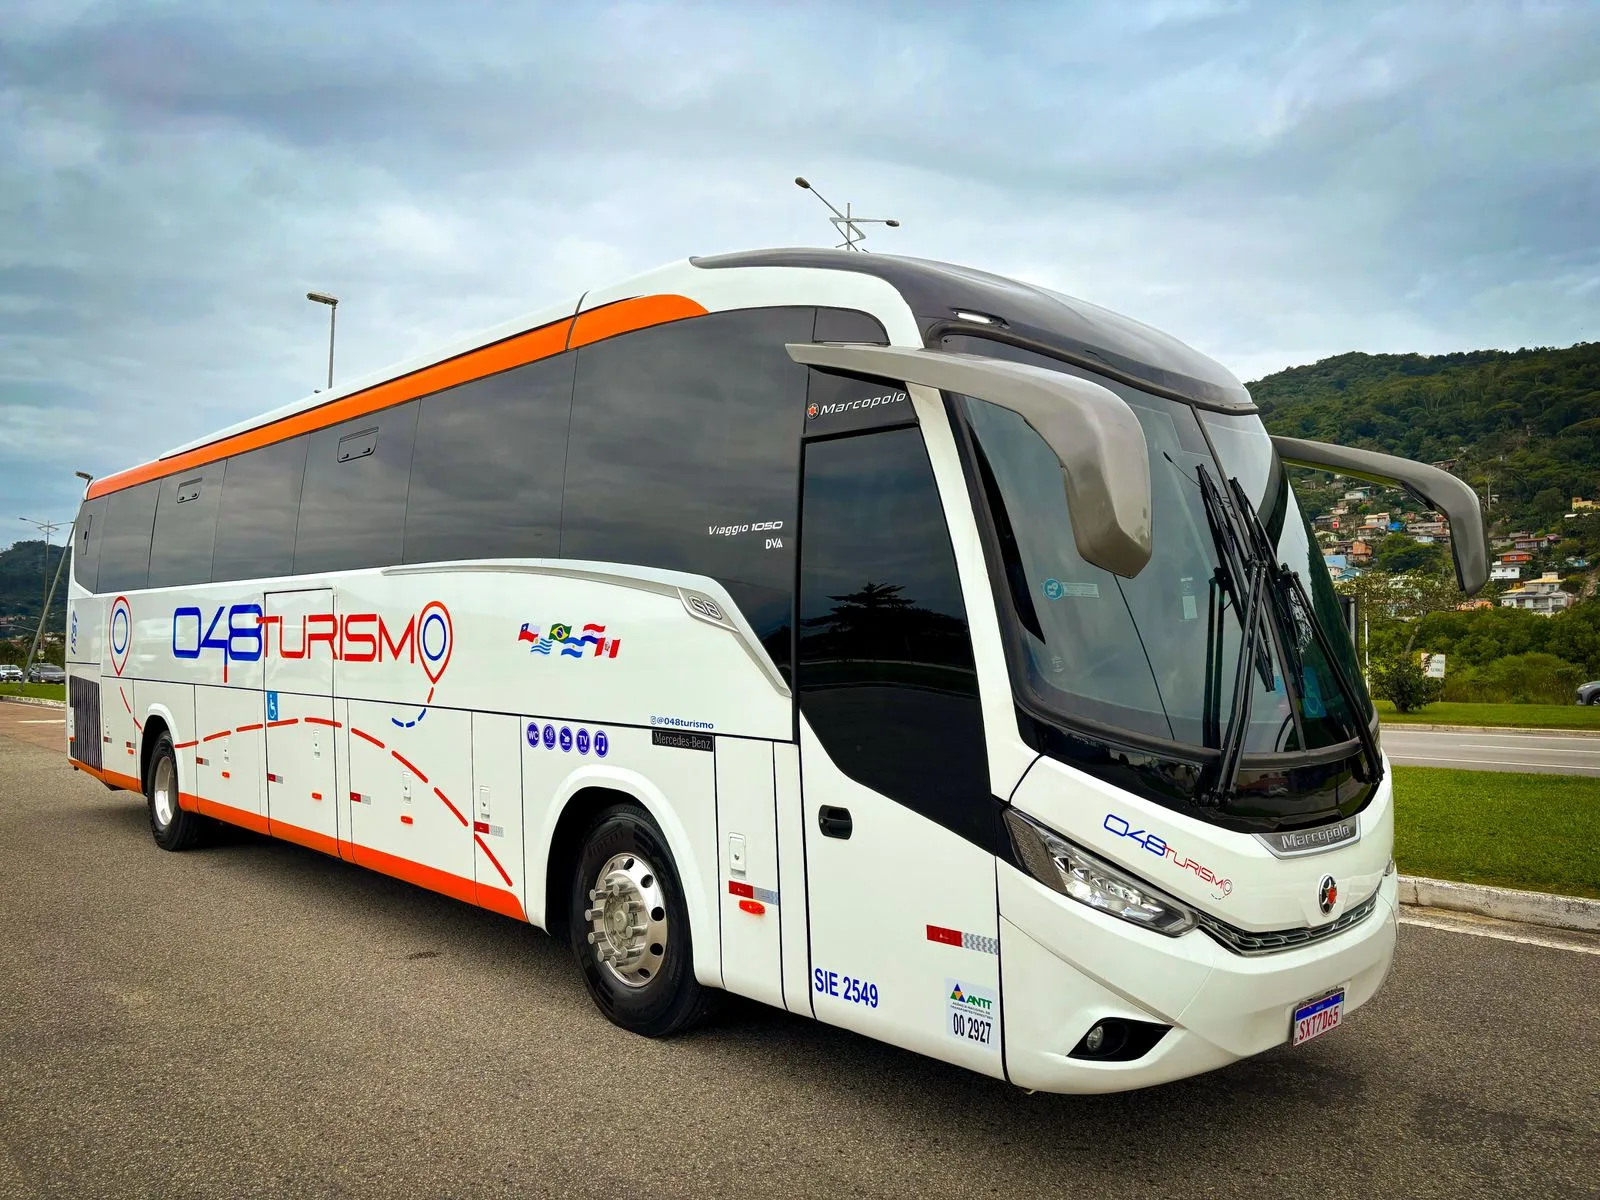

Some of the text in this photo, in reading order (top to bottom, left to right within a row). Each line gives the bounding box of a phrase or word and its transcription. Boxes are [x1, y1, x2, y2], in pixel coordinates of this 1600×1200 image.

[820, 391, 906, 416] Marcopolo
[708, 521, 783, 537] Viaggio 1050
[765, 538, 783, 550] DVA
[527, 730, 539, 741] WC
[579, 734, 588, 746] TV
[655, 732, 711, 750] Mercedes-Benz
[1281, 823, 1351, 849] Marcopolo
[815, 968, 878, 1008] SIE 2549
[966, 995, 992, 1010] ANTT
[953, 1012, 965, 1037] 00
[968, 1017, 992, 1044] 2927
[1299, 1005, 1340, 1041] SXT7D65
